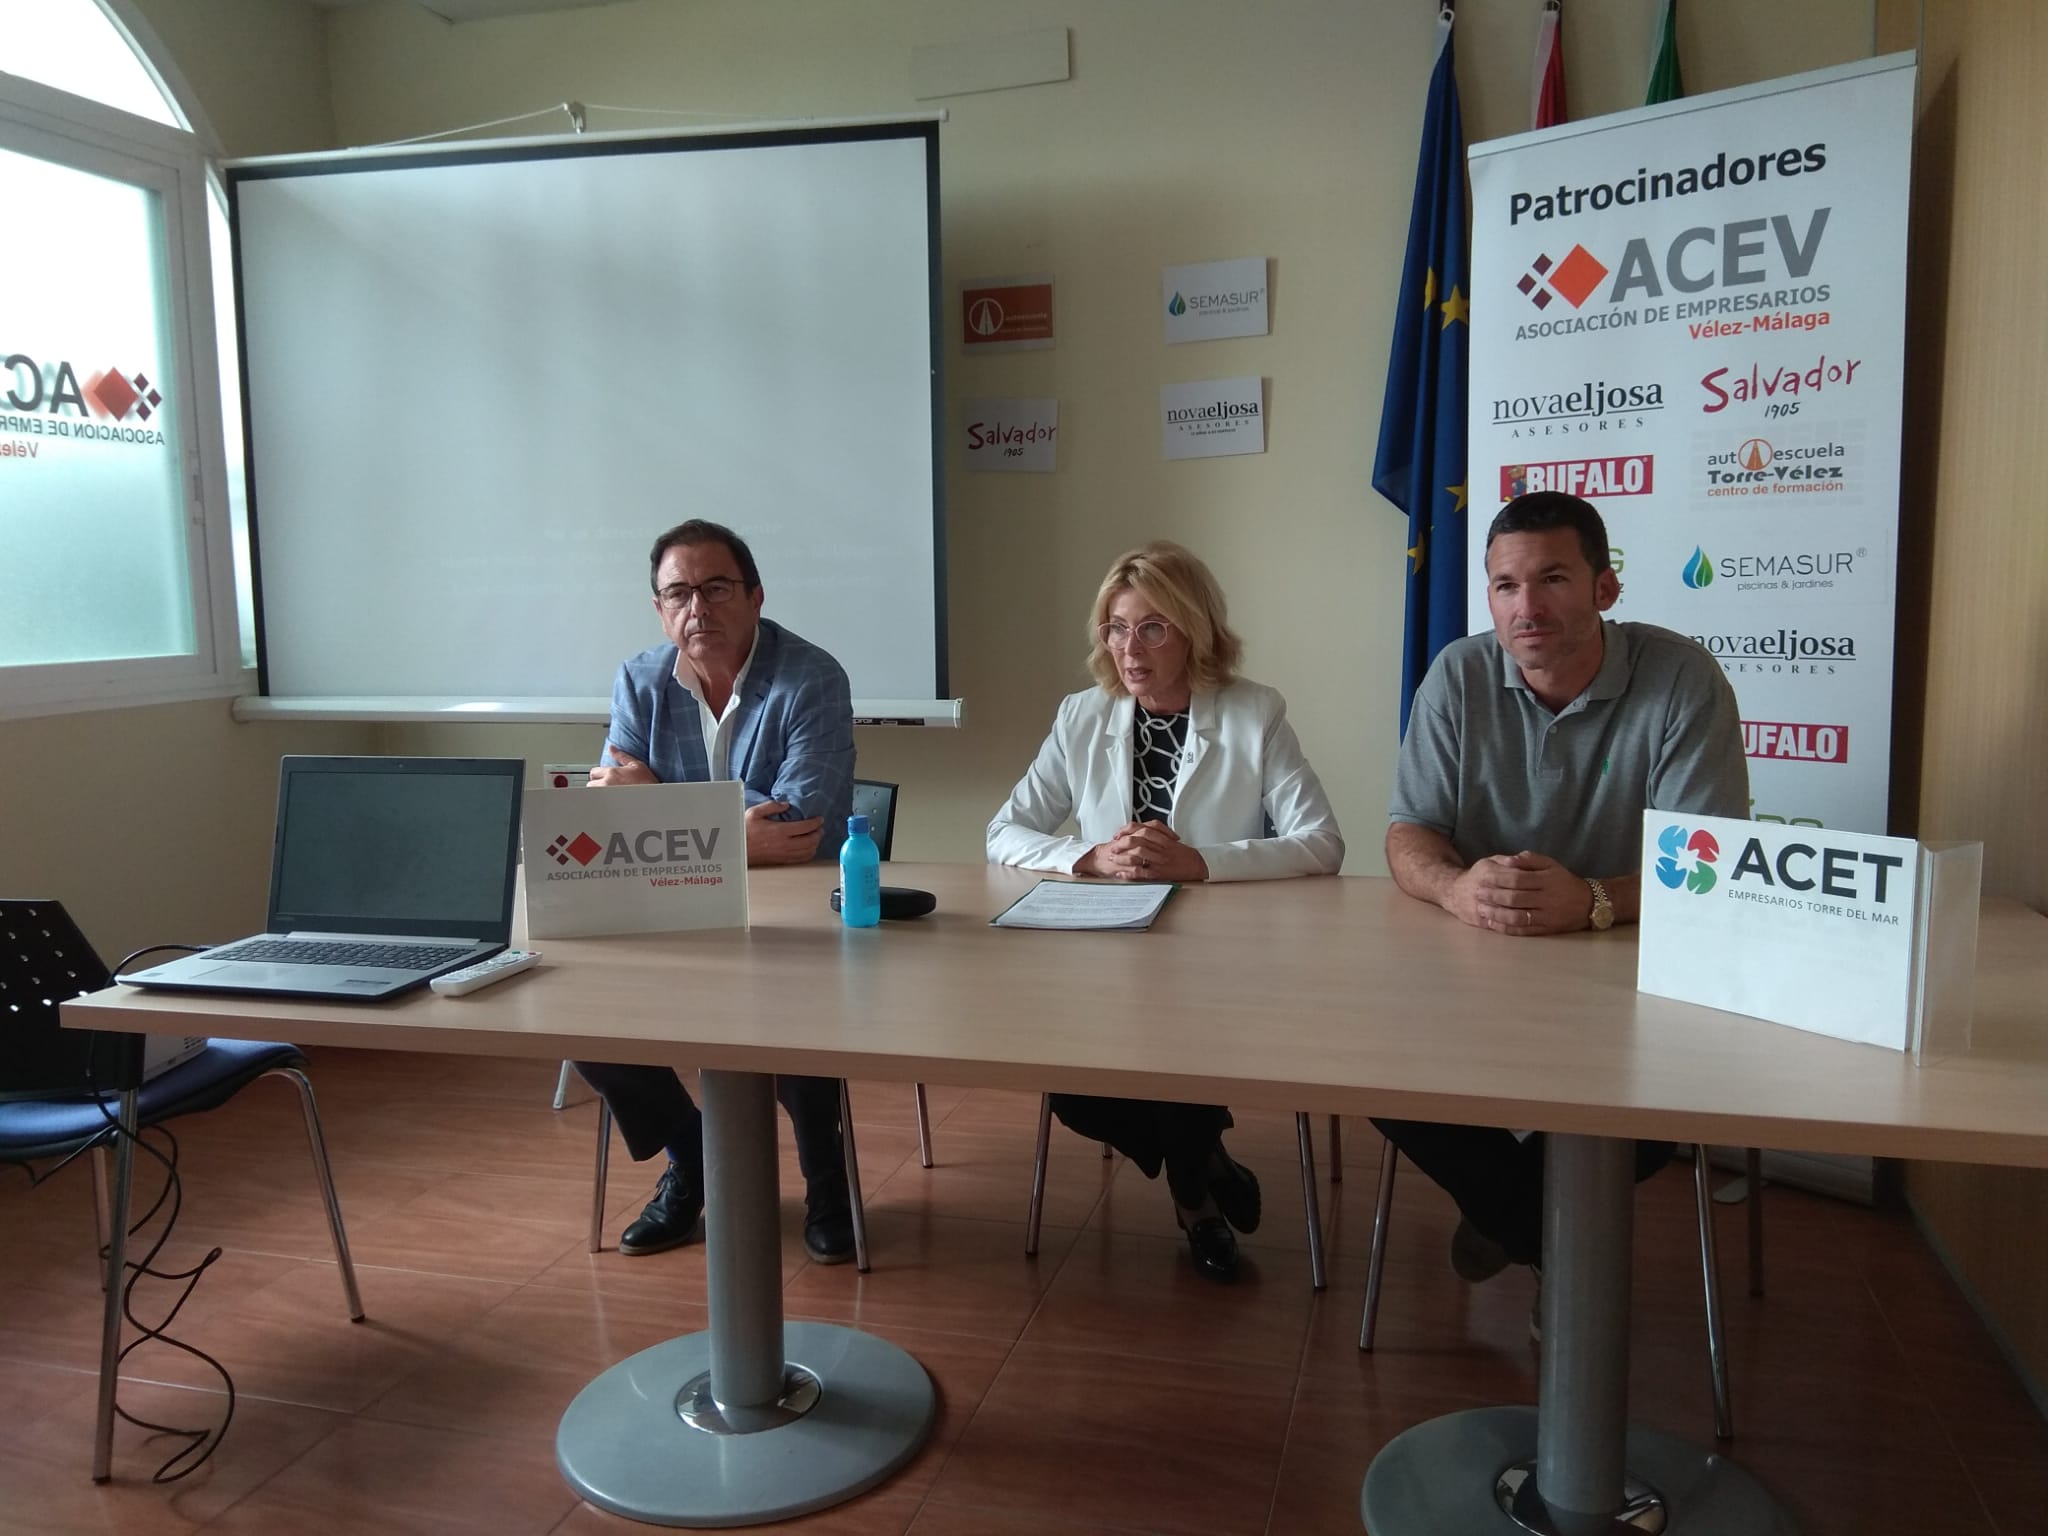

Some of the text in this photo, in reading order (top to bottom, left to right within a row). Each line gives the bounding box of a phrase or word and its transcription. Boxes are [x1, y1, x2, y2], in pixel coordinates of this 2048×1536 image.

[1510, 143, 1826, 225] Patrocinadores
[1609, 207, 1831, 303] ACEV
[1515, 285, 1831, 341] ASOCIACIÓN DE EMPRESARIOS
[1689, 310, 1830, 339] Vélez-Málaga
[1700, 355, 1861, 413] Salvador
[1167, 401, 1258, 421] novaeljosa
[1493, 381, 1663, 420] novaeljosa
[1764, 402, 1800, 419] 1905
[968, 421, 1056, 449] Salvador
[1511, 417, 1643, 438] ASESORES
[1004, 448, 1025, 457] 1905
[1526, 458, 1644, 495] BUFALO
[1707, 465, 1843, 484] Torre-Vélez
[1707, 481, 1843, 497] centro de formación
[1720, 552, 1853, 578] SEMASUR
[1737, 582, 1778, 592] piscinas
[1792, 579, 1834, 590] jardines
[1723, 663, 1836, 675] SESORES
[1741, 723, 1838, 760] UFALO
[603, 827, 720, 865] ACEV
[547, 863, 722, 881] ASOCIACIÓN DE EMPRESARIOS
[650, 875, 723, 887] Vélez-Málaga
[1731, 837, 1903, 904] ACET
[1728, 889, 1899, 926] EMPRESARIOS TORRE DEL MAR
